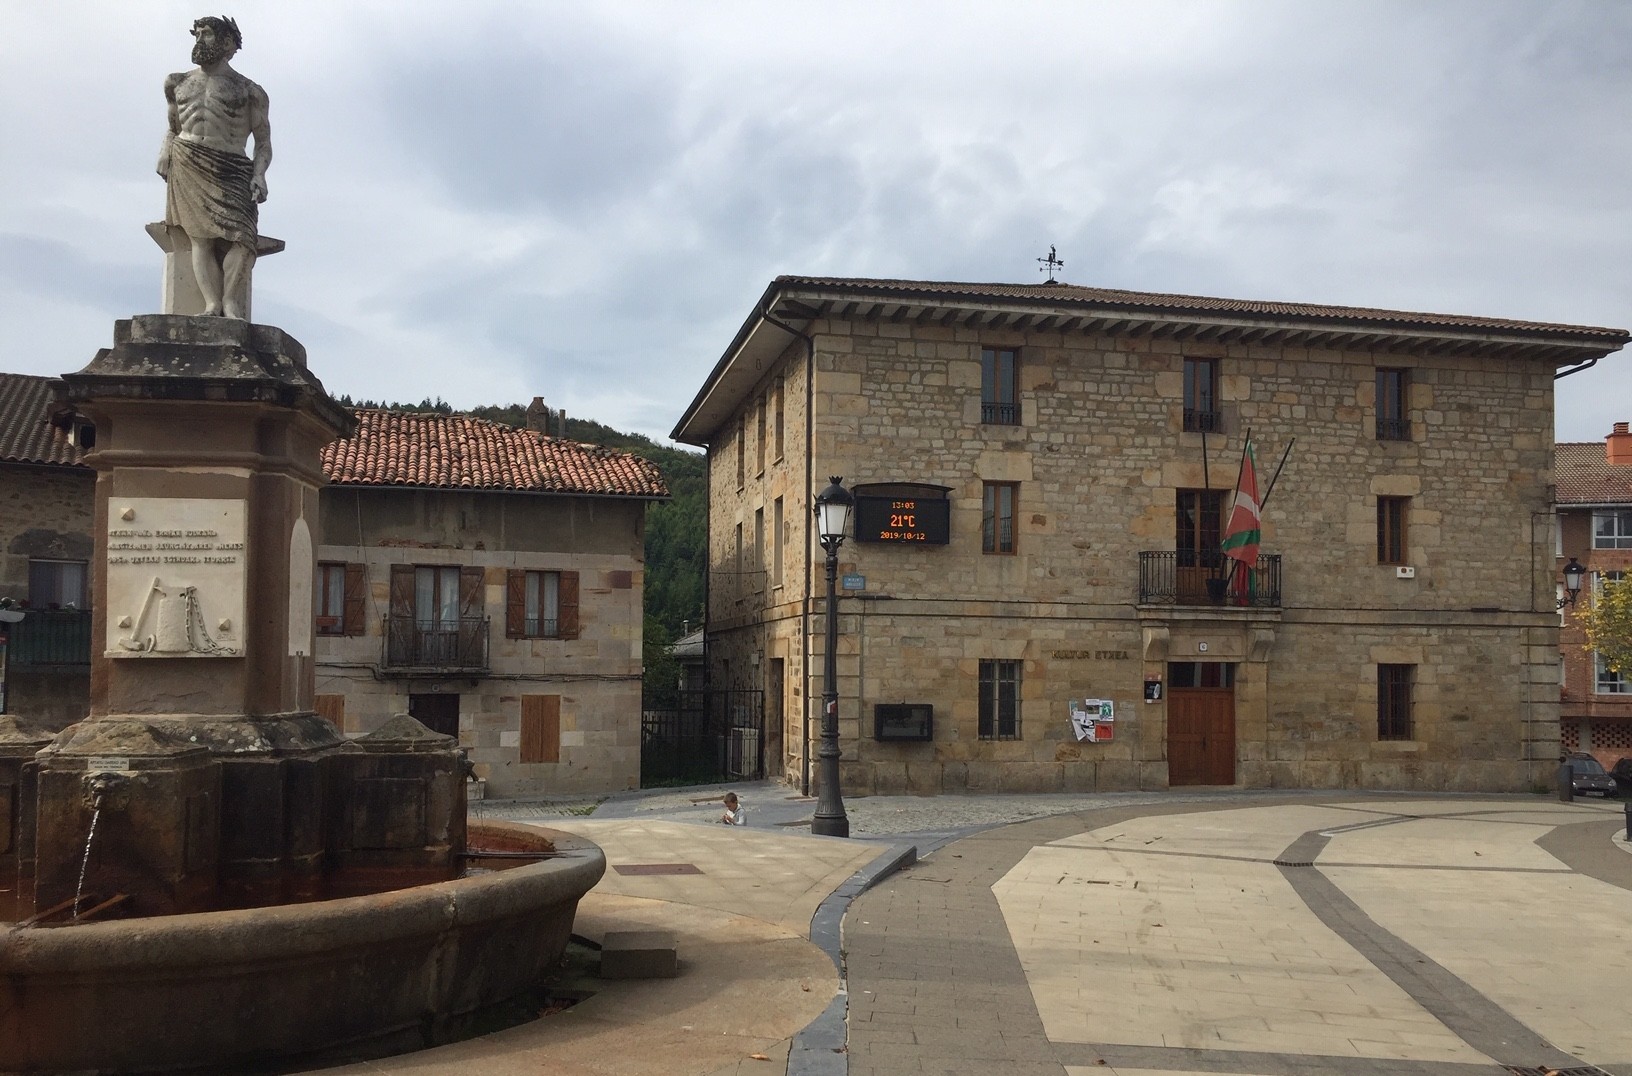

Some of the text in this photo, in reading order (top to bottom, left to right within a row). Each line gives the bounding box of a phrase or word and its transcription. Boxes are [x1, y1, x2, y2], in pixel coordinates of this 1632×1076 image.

[890, 515, 915, 527] 21°C
[880, 531, 925, 540] 2019/10/12
[1051, 649, 1129, 660] KULTUR ETXEA
